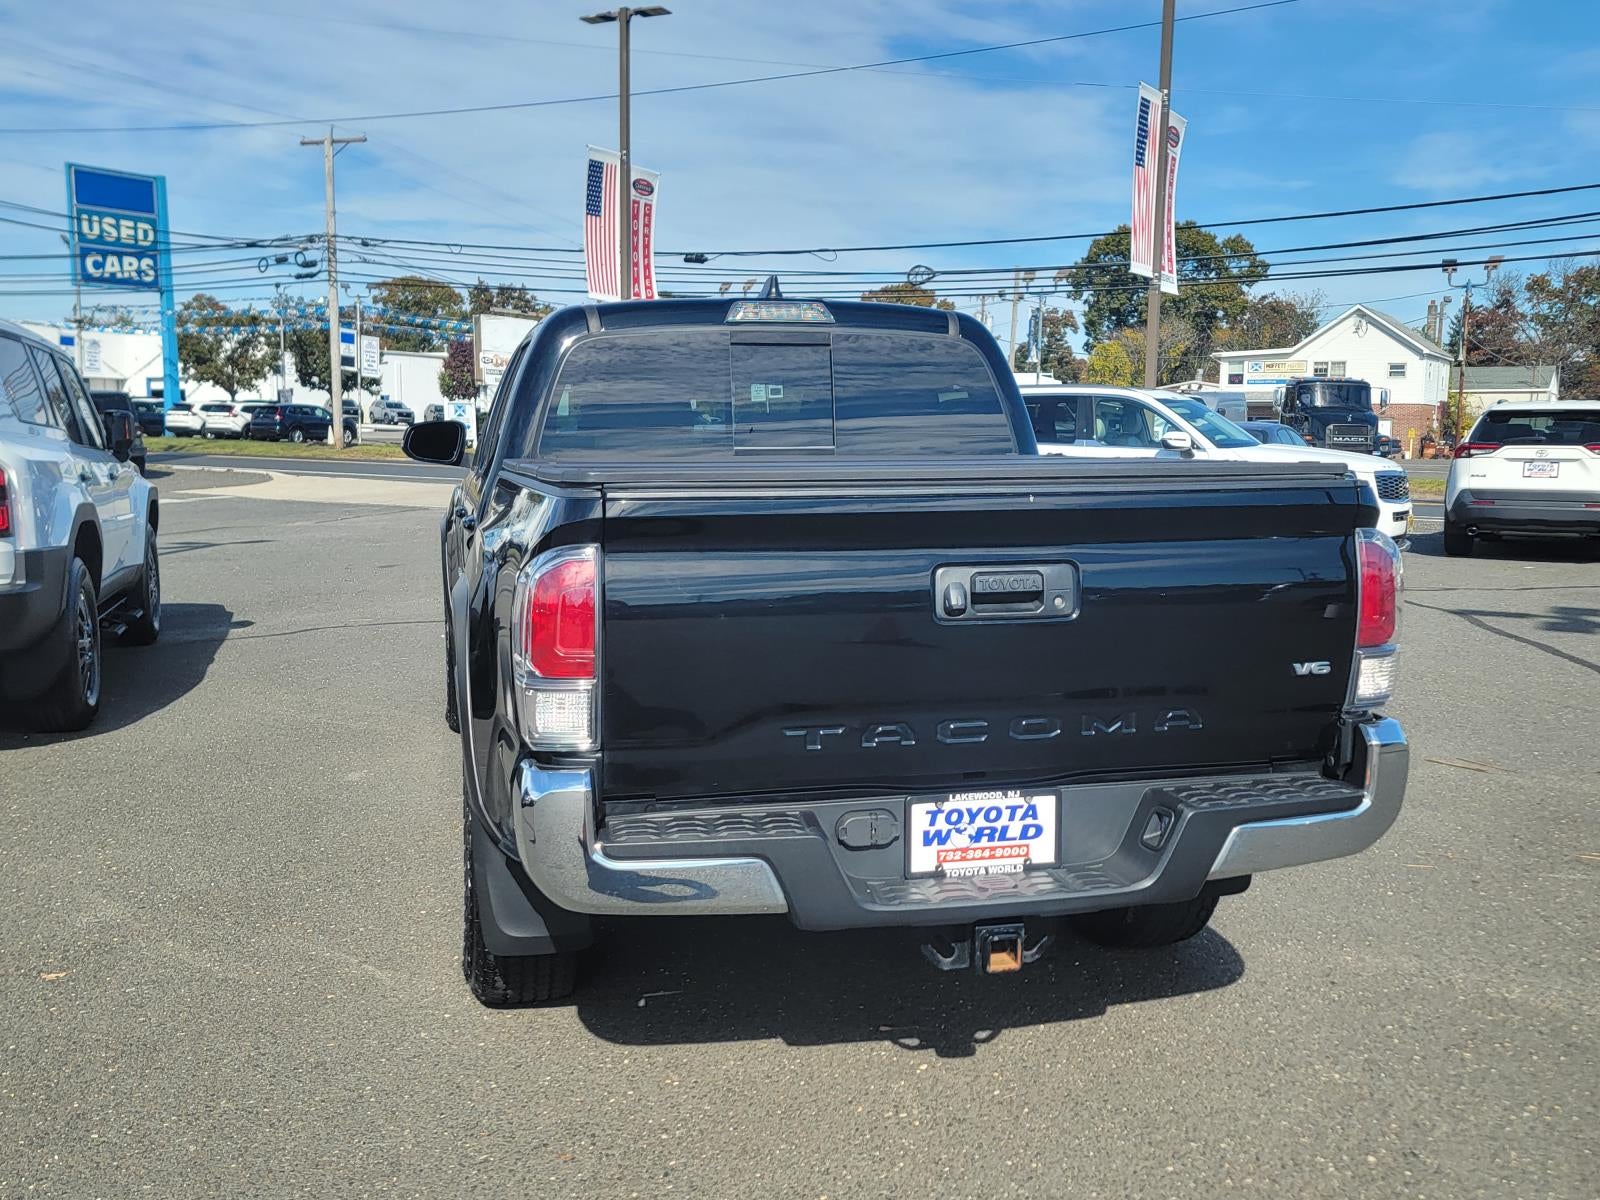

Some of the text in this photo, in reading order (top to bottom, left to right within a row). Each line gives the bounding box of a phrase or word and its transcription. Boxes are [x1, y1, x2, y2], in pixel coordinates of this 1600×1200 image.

[80, 213, 155, 247] USED
[644, 205, 652, 297] CERTIFIED
[84, 252, 156, 283] CARS
[979, 578, 1039, 591] TOYOTA
[1293, 661, 1331, 675] V6
[782, 708, 1204, 750] TACOMA
[949, 790, 1021, 801] LAKEWOOD, NJ
[925, 803, 1039, 827] TOYOTA
[945, 864, 1024, 878] TOYOTA WORLD
